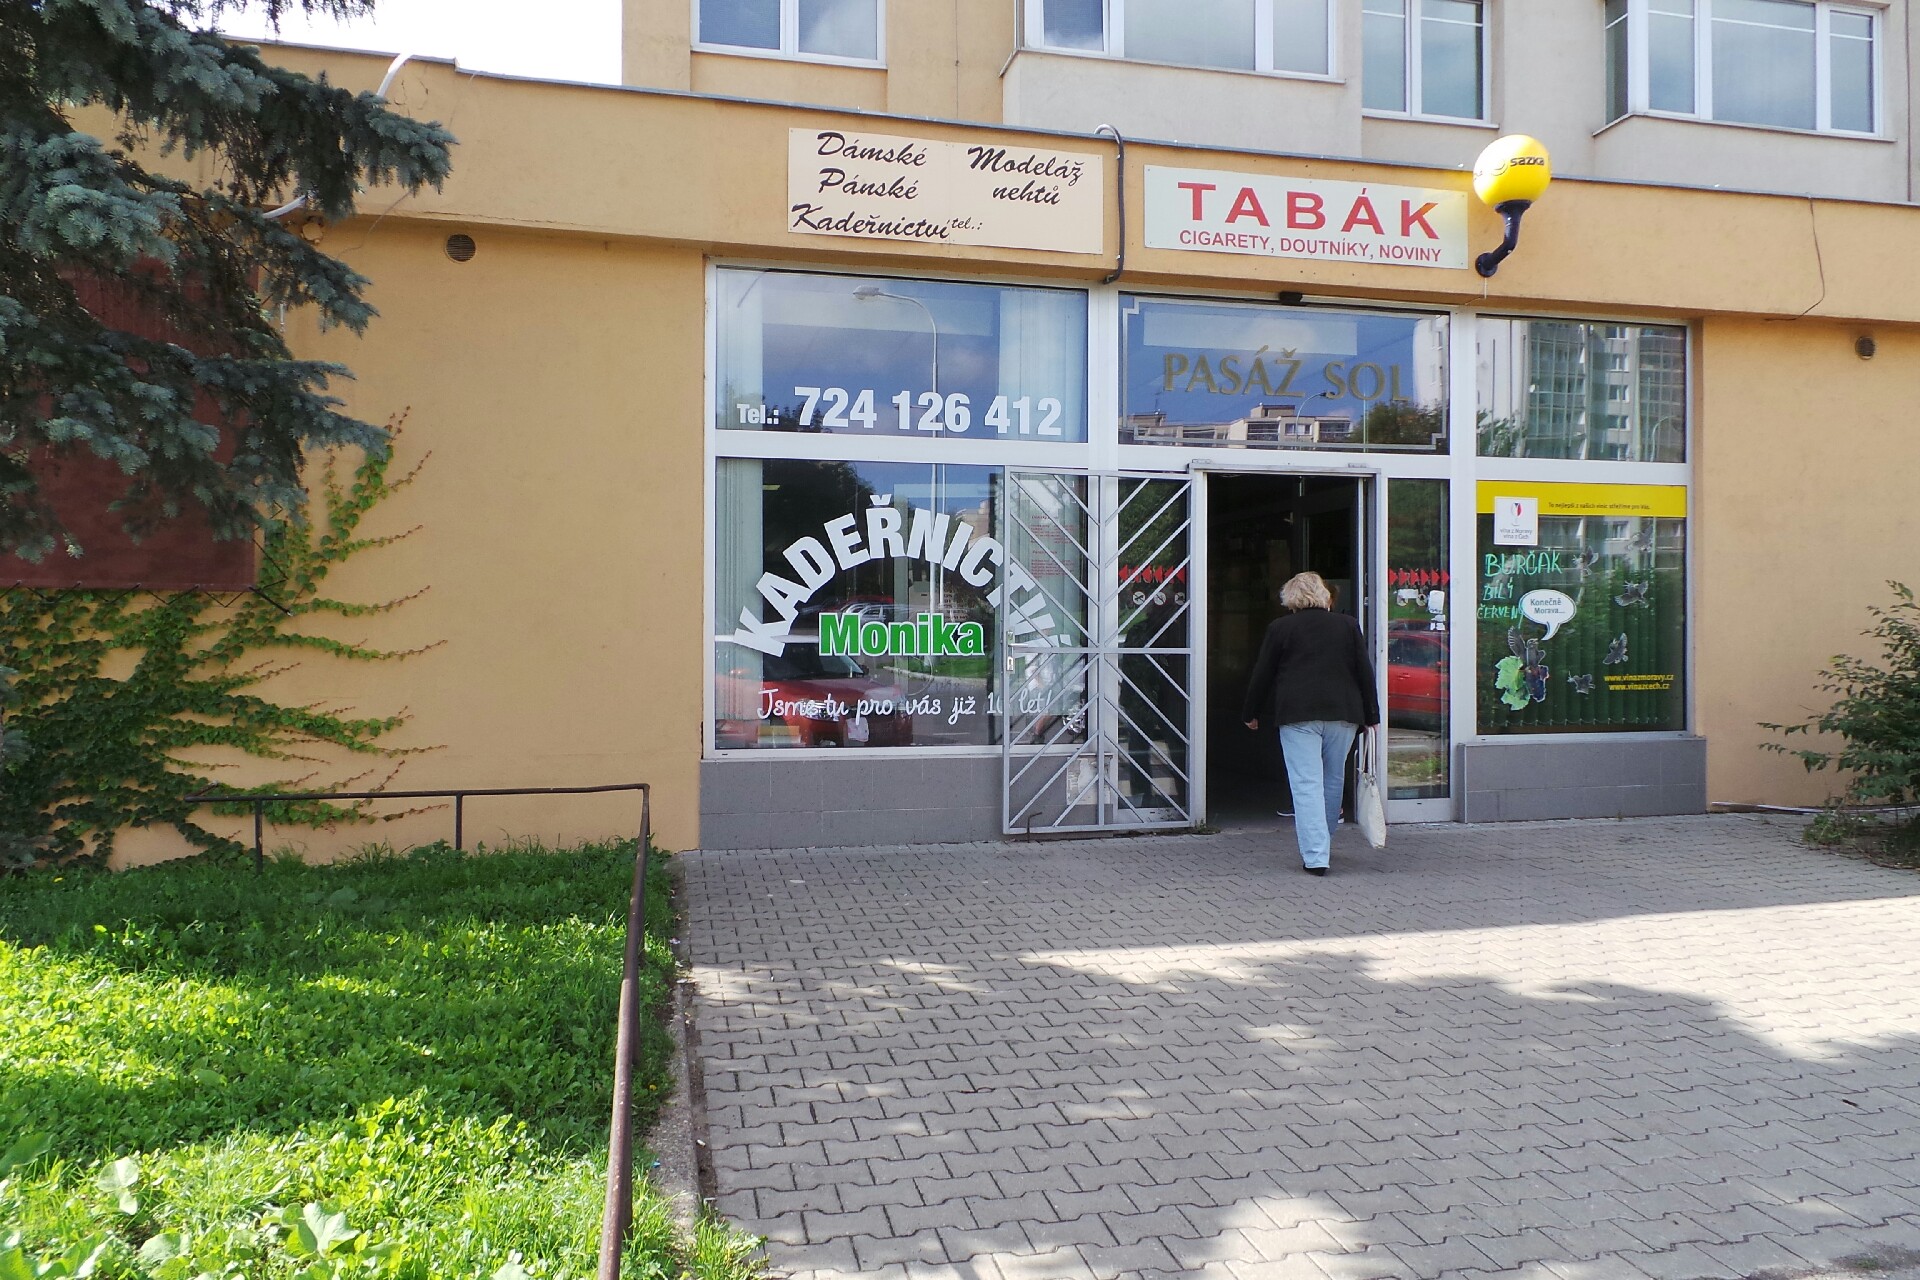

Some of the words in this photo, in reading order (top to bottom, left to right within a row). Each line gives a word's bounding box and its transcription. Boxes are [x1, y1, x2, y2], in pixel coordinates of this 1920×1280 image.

[817, 132, 927, 167] Dámské
[967, 147, 1083, 186] Modeláž
[819, 167, 918, 200] Pánské
[992, 180, 1060, 205] nehtů
[791, 203, 950, 239] Kadeřnictví
[951, 217, 983, 231] tel.:
[1178, 182, 1439, 240] TABÁK
[1179, 229, 1275, 254] CIGARETY,
[1280, 238, 1374, 261] DOUTNÍKY,
[1379, 244, 1441, 263] NOVINY
[1163, 344, 1305, 397] PASÁŽ
[1323, 361, 1412, 401] SOL
[736, 403, 779, 425] Tel.:
[795, 386, 877, 429] 724
[892, 390, 971, 433] 126
[984, 395, 1062, 436] 412
[1484, 548, 1563, 577] BURČÁK
[1530, 598, 1562, 606] Konečně
[818, 612, 986, 658] Monika
[757, 687, 818, 719] Jsme
[825, 692, 849, 718] tu
[855, 700, 894, 725] pro
[905, 694, 941, 716] vás
[947, 695, 976, 726] již
